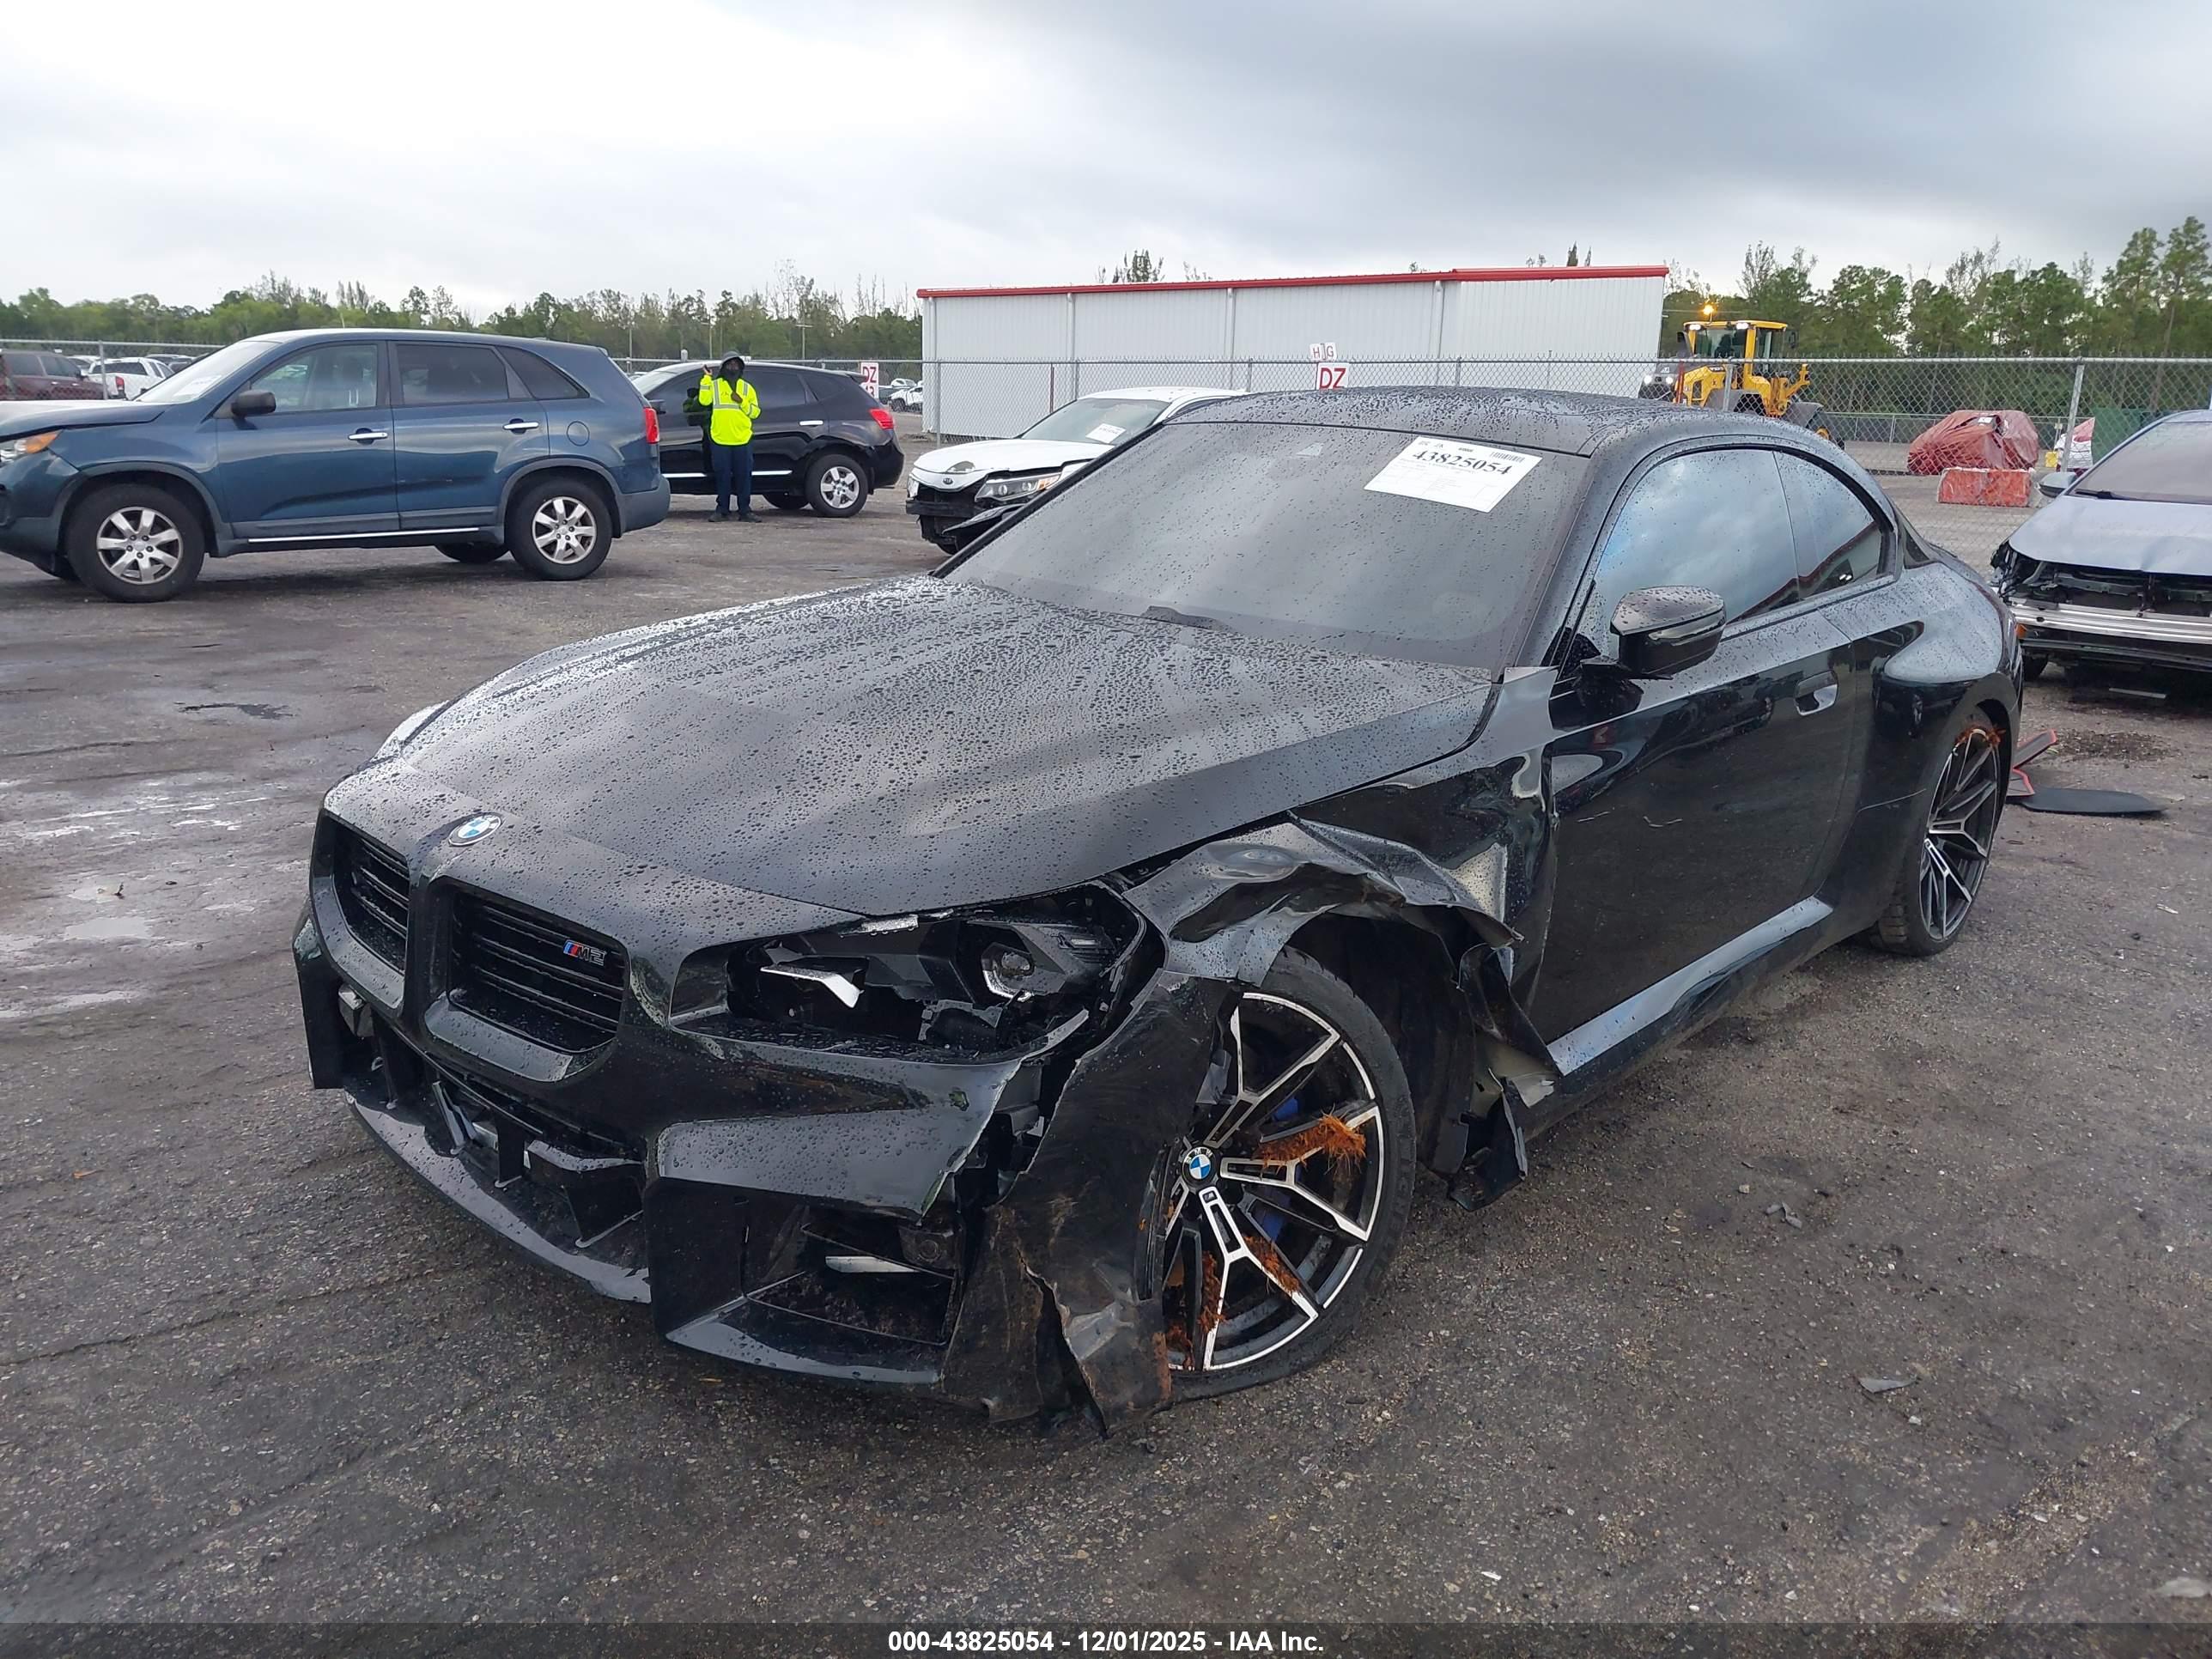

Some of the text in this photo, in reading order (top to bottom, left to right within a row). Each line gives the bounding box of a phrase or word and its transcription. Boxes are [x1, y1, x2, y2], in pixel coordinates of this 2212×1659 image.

[1319, 367, 1346, 389] DZ
[1412, 449, 1513, 475] 43825054
[577, 945, 607, 966] M2
[1185, 1147, 1213, 1164] BMW
